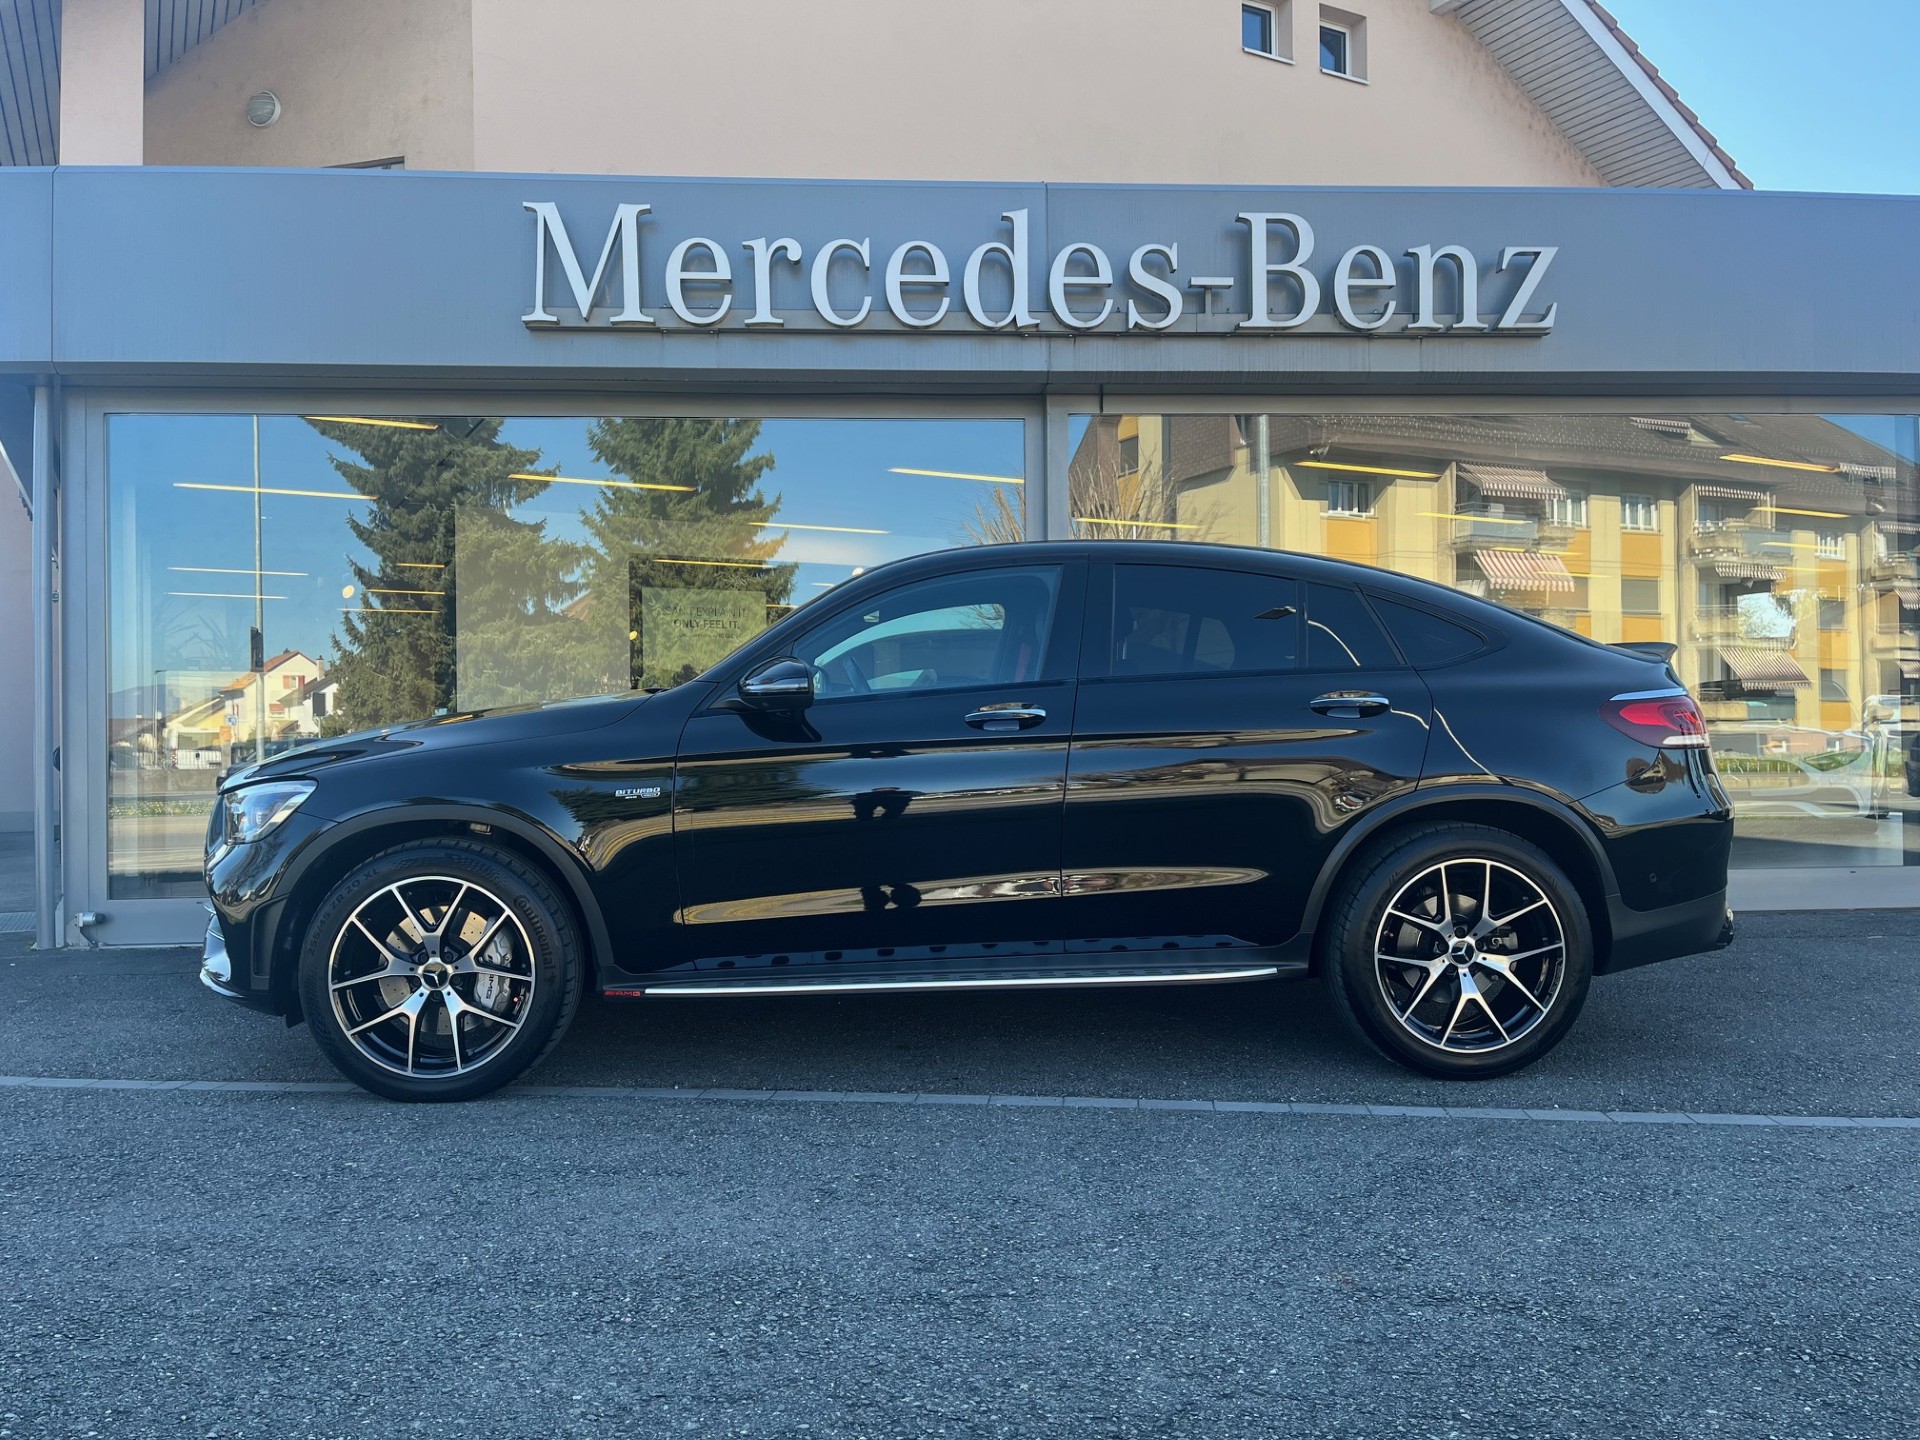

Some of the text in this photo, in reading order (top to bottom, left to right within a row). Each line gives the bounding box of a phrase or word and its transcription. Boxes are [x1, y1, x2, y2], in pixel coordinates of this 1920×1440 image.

[521, 200, 1559, 332] Mercedes-Benz
[673, 618, 700, 629] ONLY
[703, 619, 727, 629] FEEL
[308, 911, 330, 957] 255/45
[330, 894, 345, 911] ZR
[345, 879, 361, 895] 20
[362, 867, 380, 880] XL
[513, 894, 556, 970] Continental
